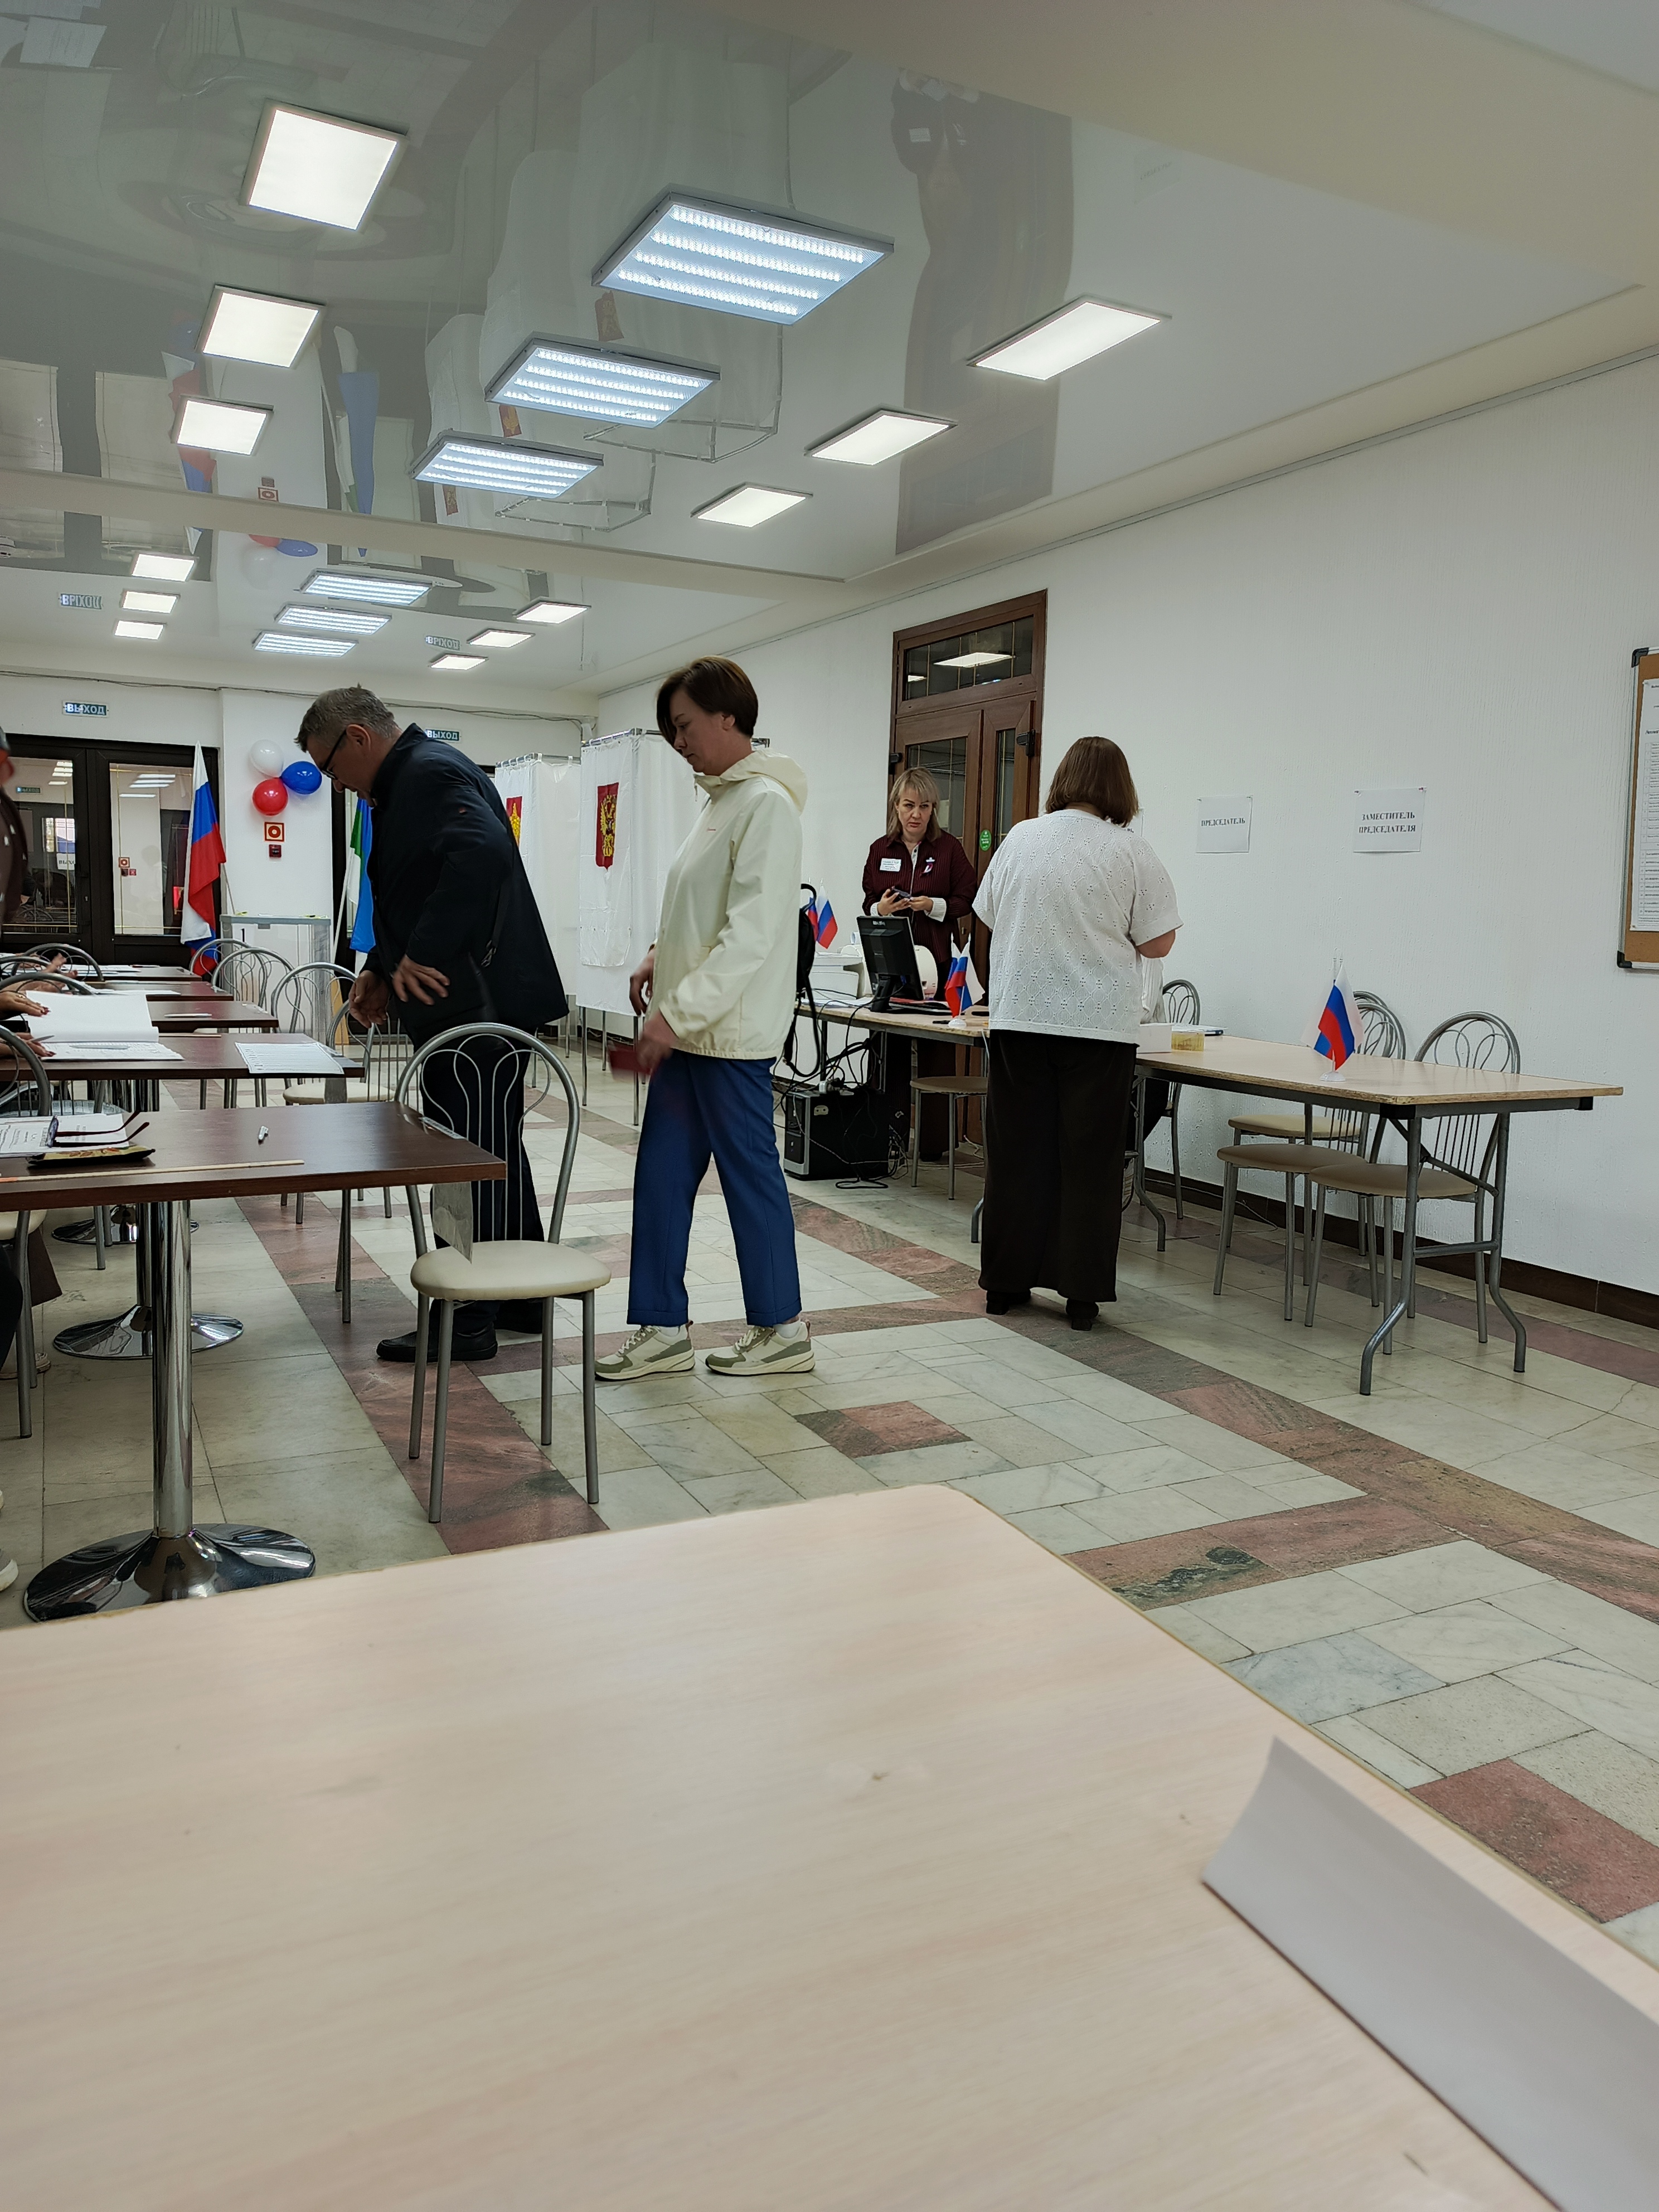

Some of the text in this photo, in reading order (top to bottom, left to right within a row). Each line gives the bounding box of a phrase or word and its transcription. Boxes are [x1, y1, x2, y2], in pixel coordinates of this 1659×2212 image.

[67, 704, 105, 715] ВЫХОД
[427, 730, 458, 740] ВЫХОД
[1362, 812, 1415, 821] ЗАМЕСТИТЕЛЬ
[1201, 817, 1245, 827] ПРЕДСЕДАТЕЛЬ
[1359, 824, 1416, 834] ПРЕДСЕДАТЕЛЯ
